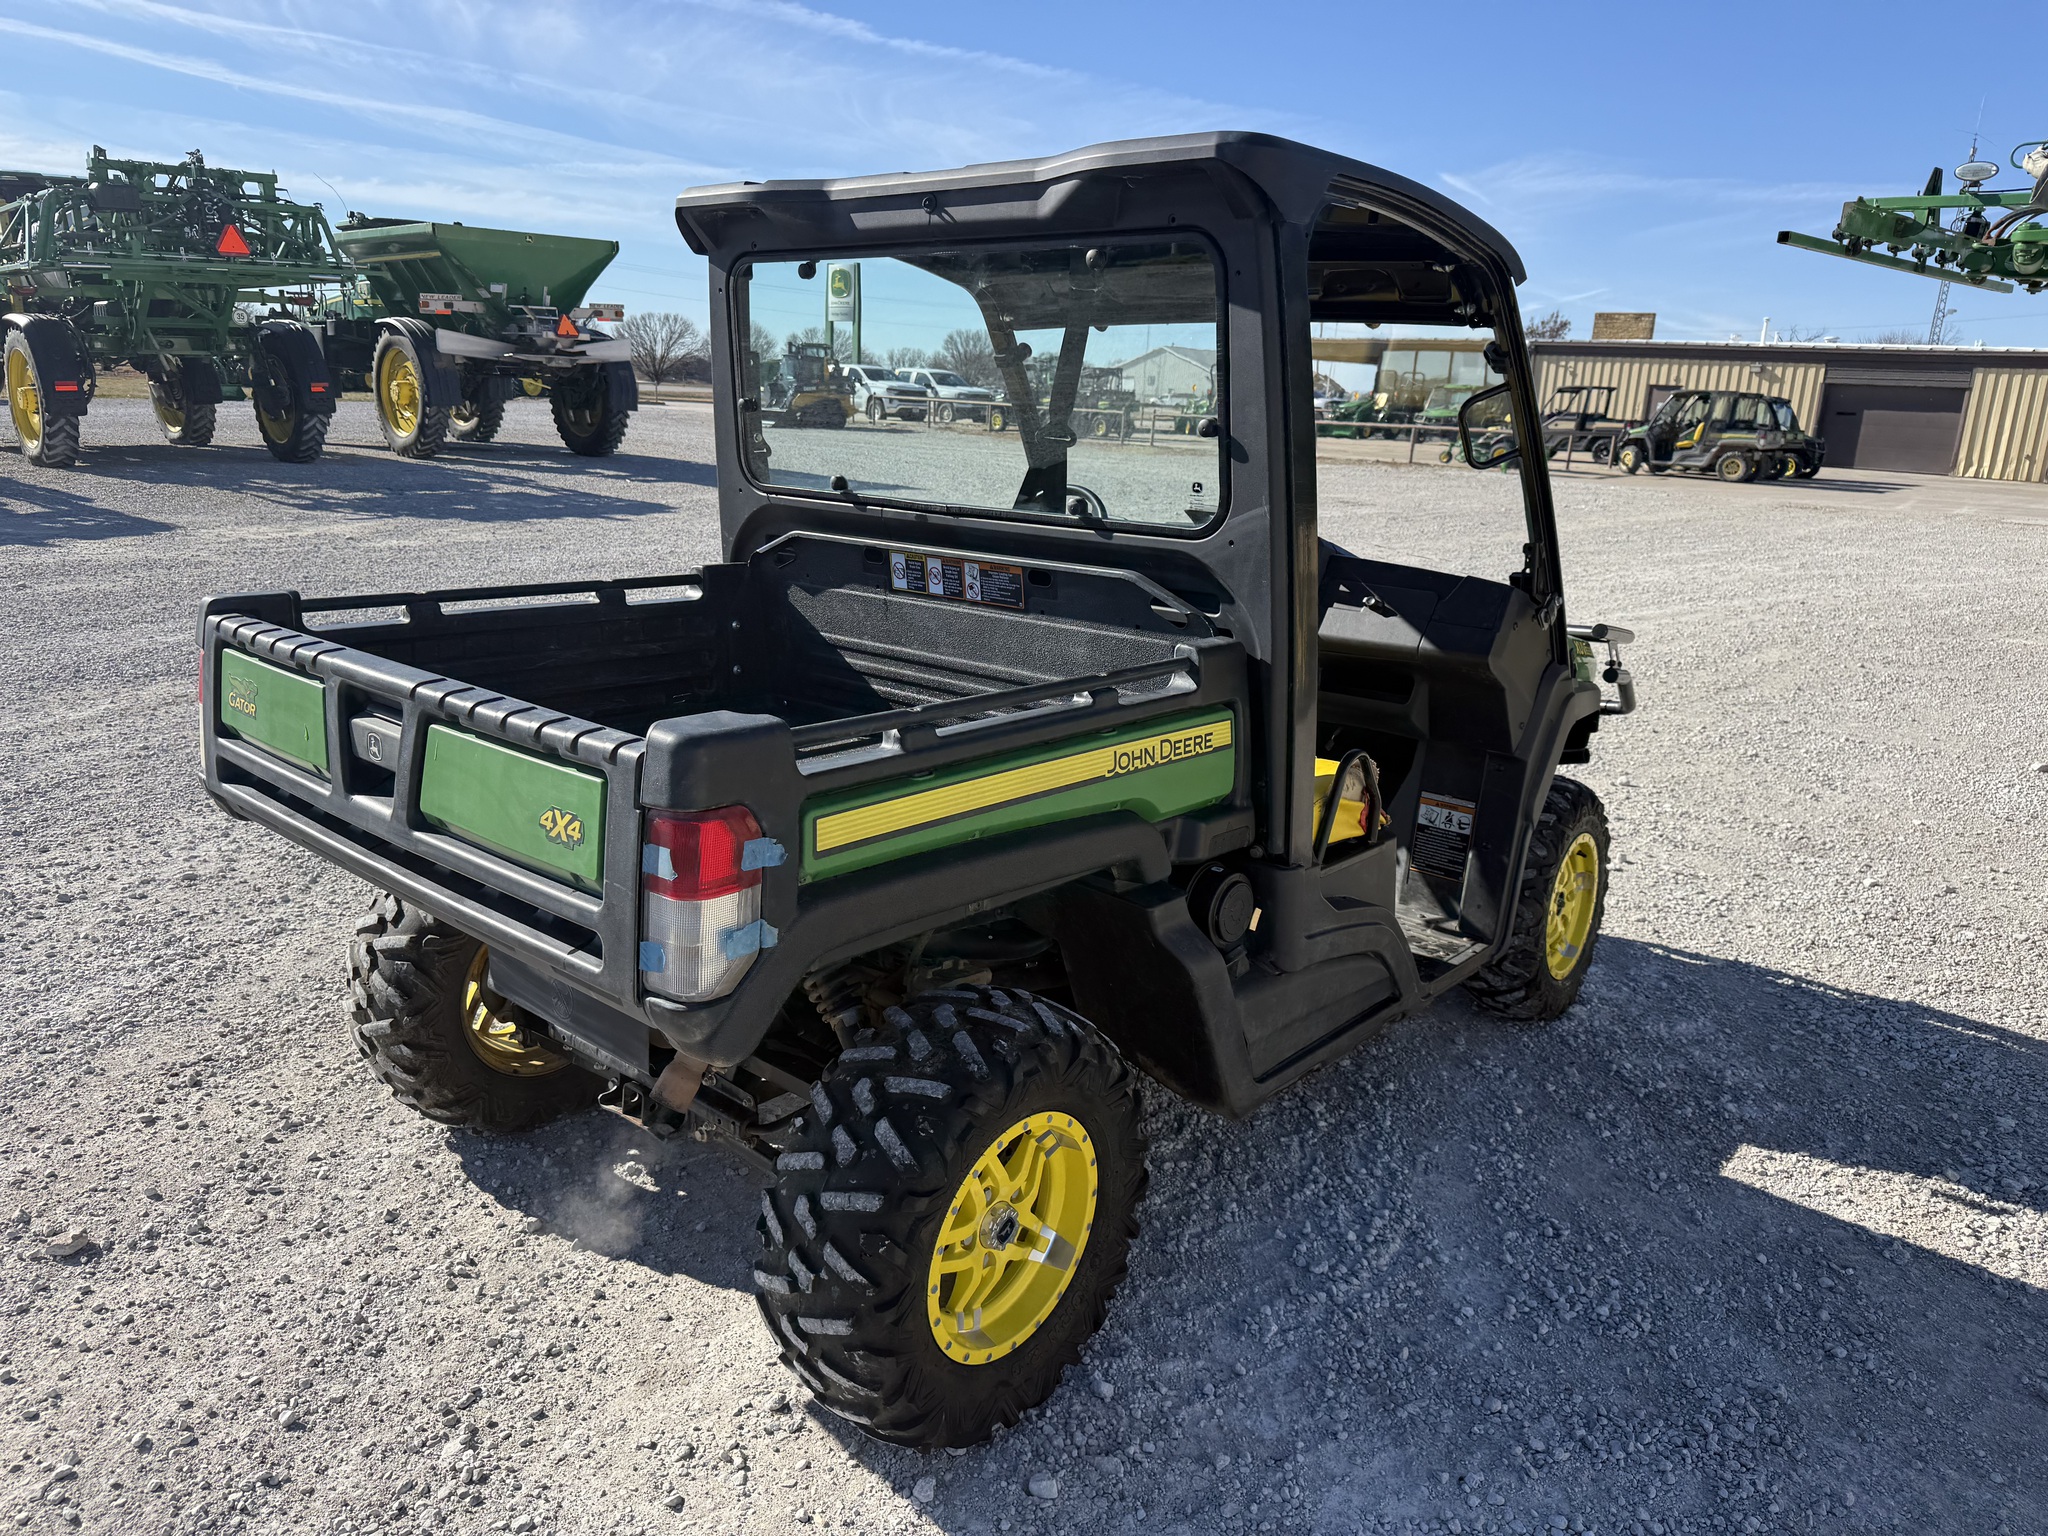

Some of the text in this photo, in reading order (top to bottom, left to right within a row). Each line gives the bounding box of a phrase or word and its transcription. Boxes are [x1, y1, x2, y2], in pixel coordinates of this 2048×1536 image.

[236, 312, 245, 320] 35
[228, 691, 256, 716] GATOR
[1107, 732, 1214, 774] JOHN DEERE
[540, 808, 582, 843] 4X4
